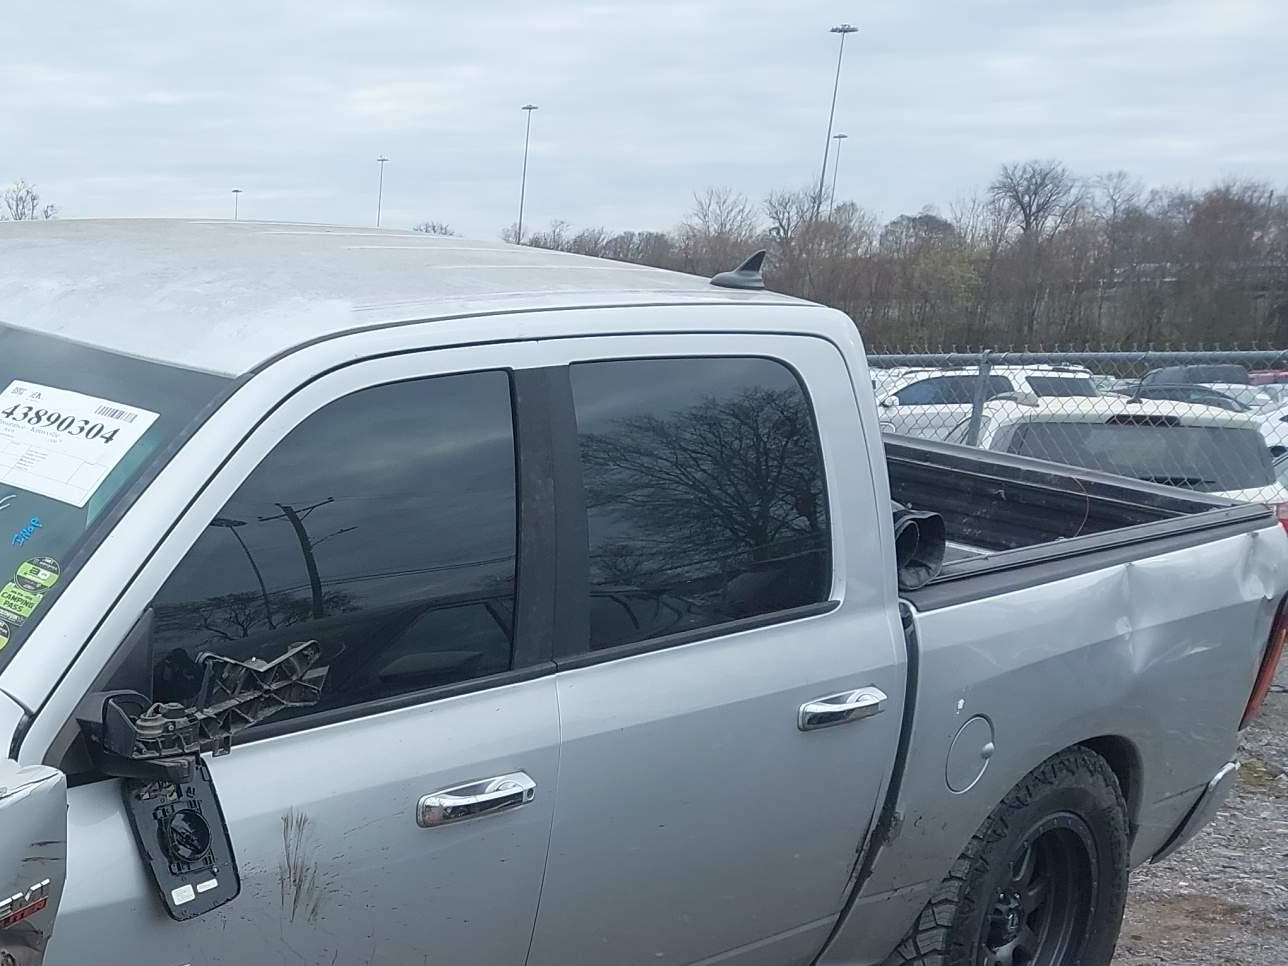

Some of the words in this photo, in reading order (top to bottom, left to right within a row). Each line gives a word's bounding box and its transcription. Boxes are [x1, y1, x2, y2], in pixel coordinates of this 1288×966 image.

[1, 403, 121, 444] 43890304
[1, 592, 35, 609] CAMPING
[3, 600, 25, 613] PASS
